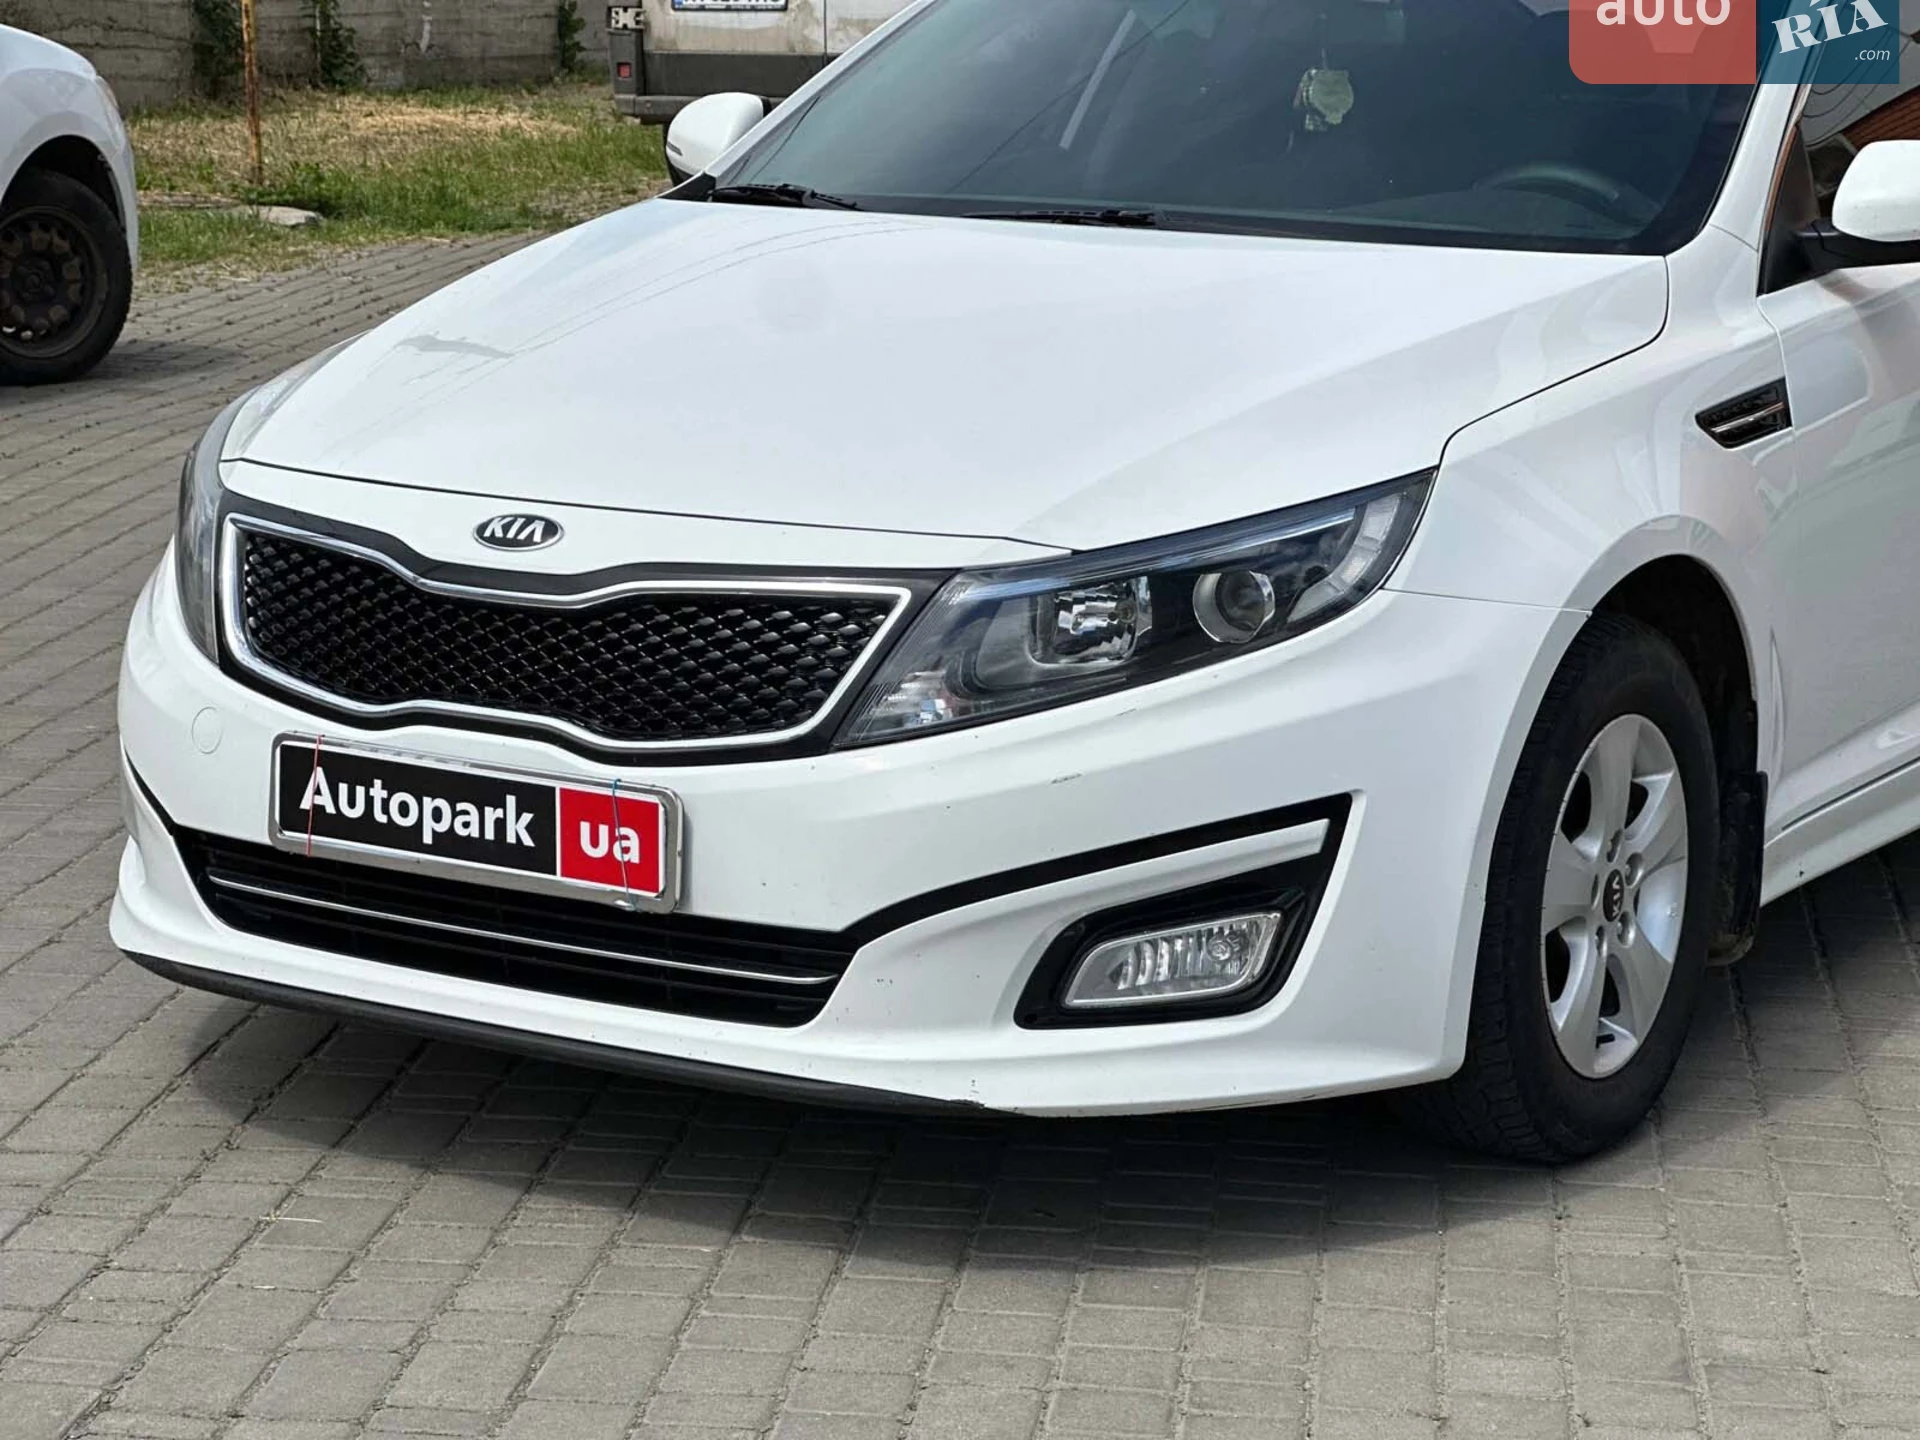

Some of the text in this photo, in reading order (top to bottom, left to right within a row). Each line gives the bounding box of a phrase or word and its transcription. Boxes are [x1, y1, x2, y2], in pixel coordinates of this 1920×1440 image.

[483, 516, 546, 543] KIA
[299, 766, 640, 864] Autopark ua
